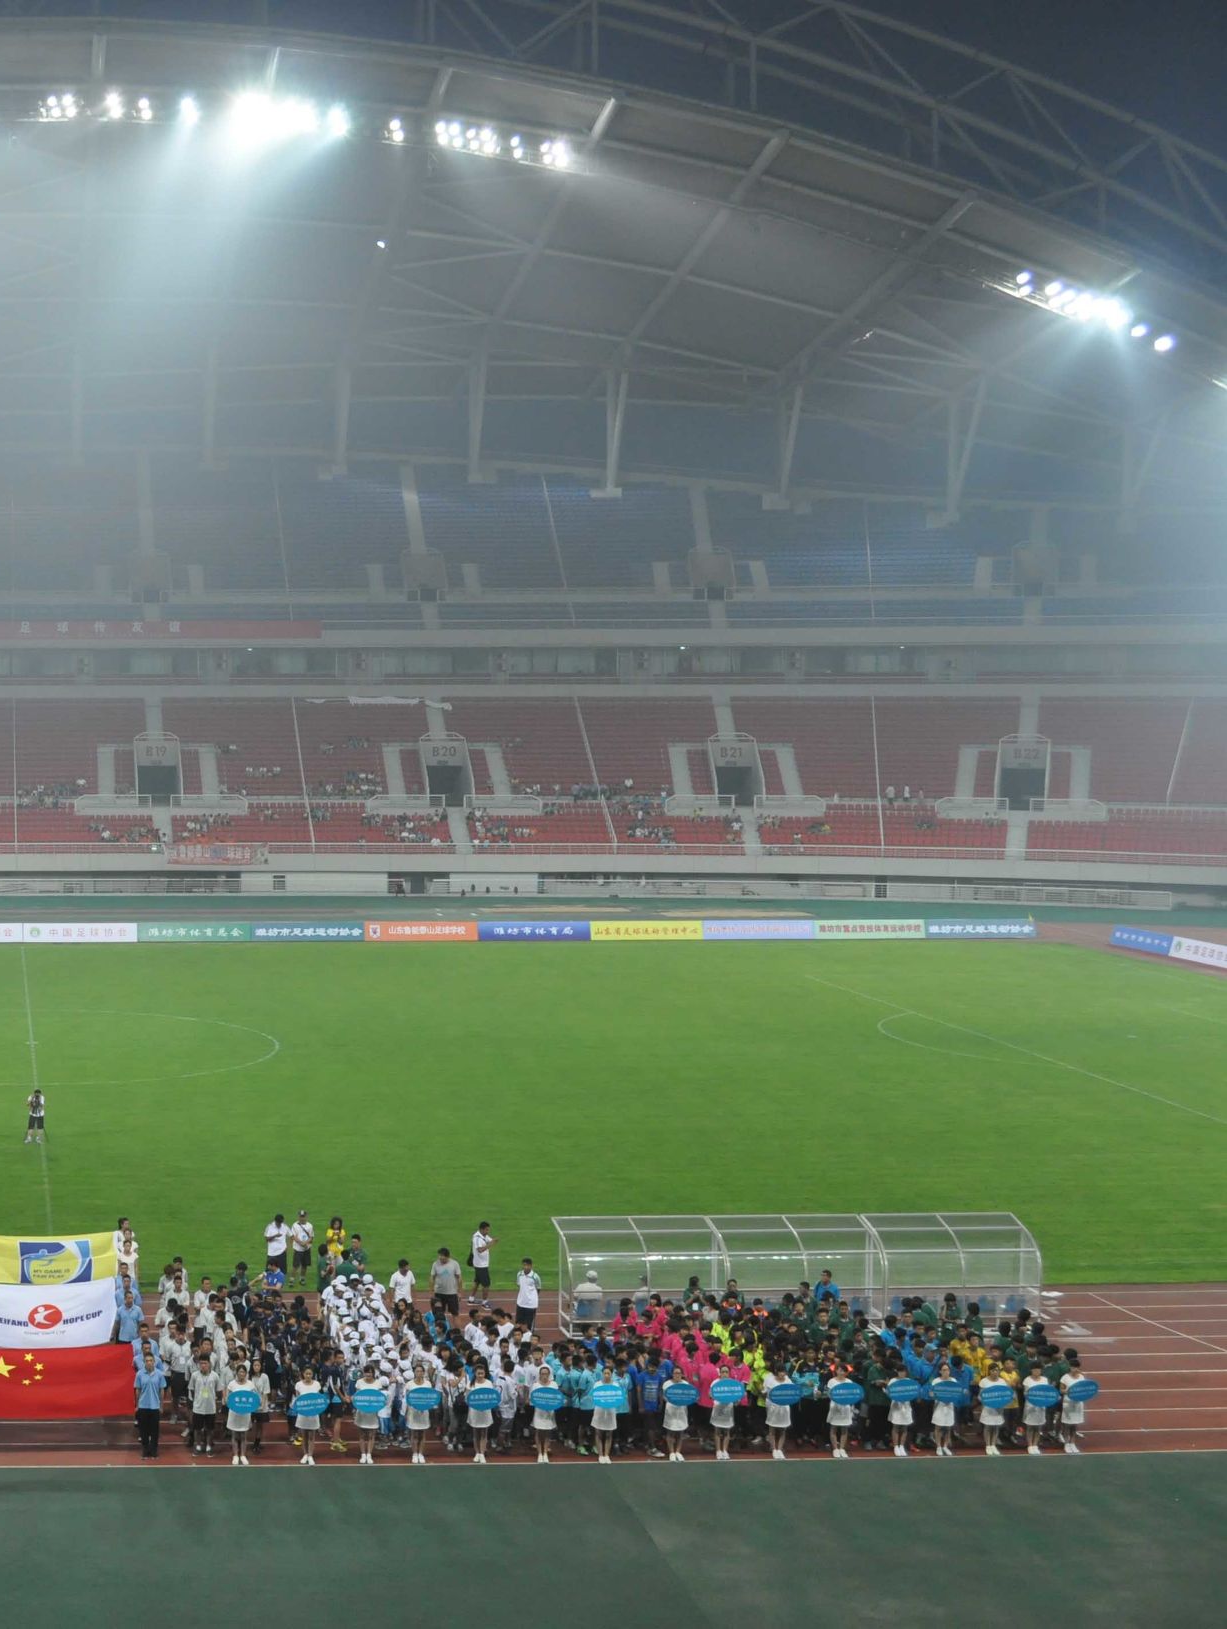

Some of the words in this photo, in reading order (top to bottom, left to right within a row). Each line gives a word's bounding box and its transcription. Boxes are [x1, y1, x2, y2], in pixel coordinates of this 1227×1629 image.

[49, 928, 128, 938] 中国足球协会
[148, 928, 244, 938] 潍坊市体育总会
[388, 925, 466, 935] 山东鲁能泰山足球学校
[493, 926, 574, 936] 潍坊市体育局
[63, 1316, 85, 1325] HOPE
[85, 1310, 103, 1321] CUP
